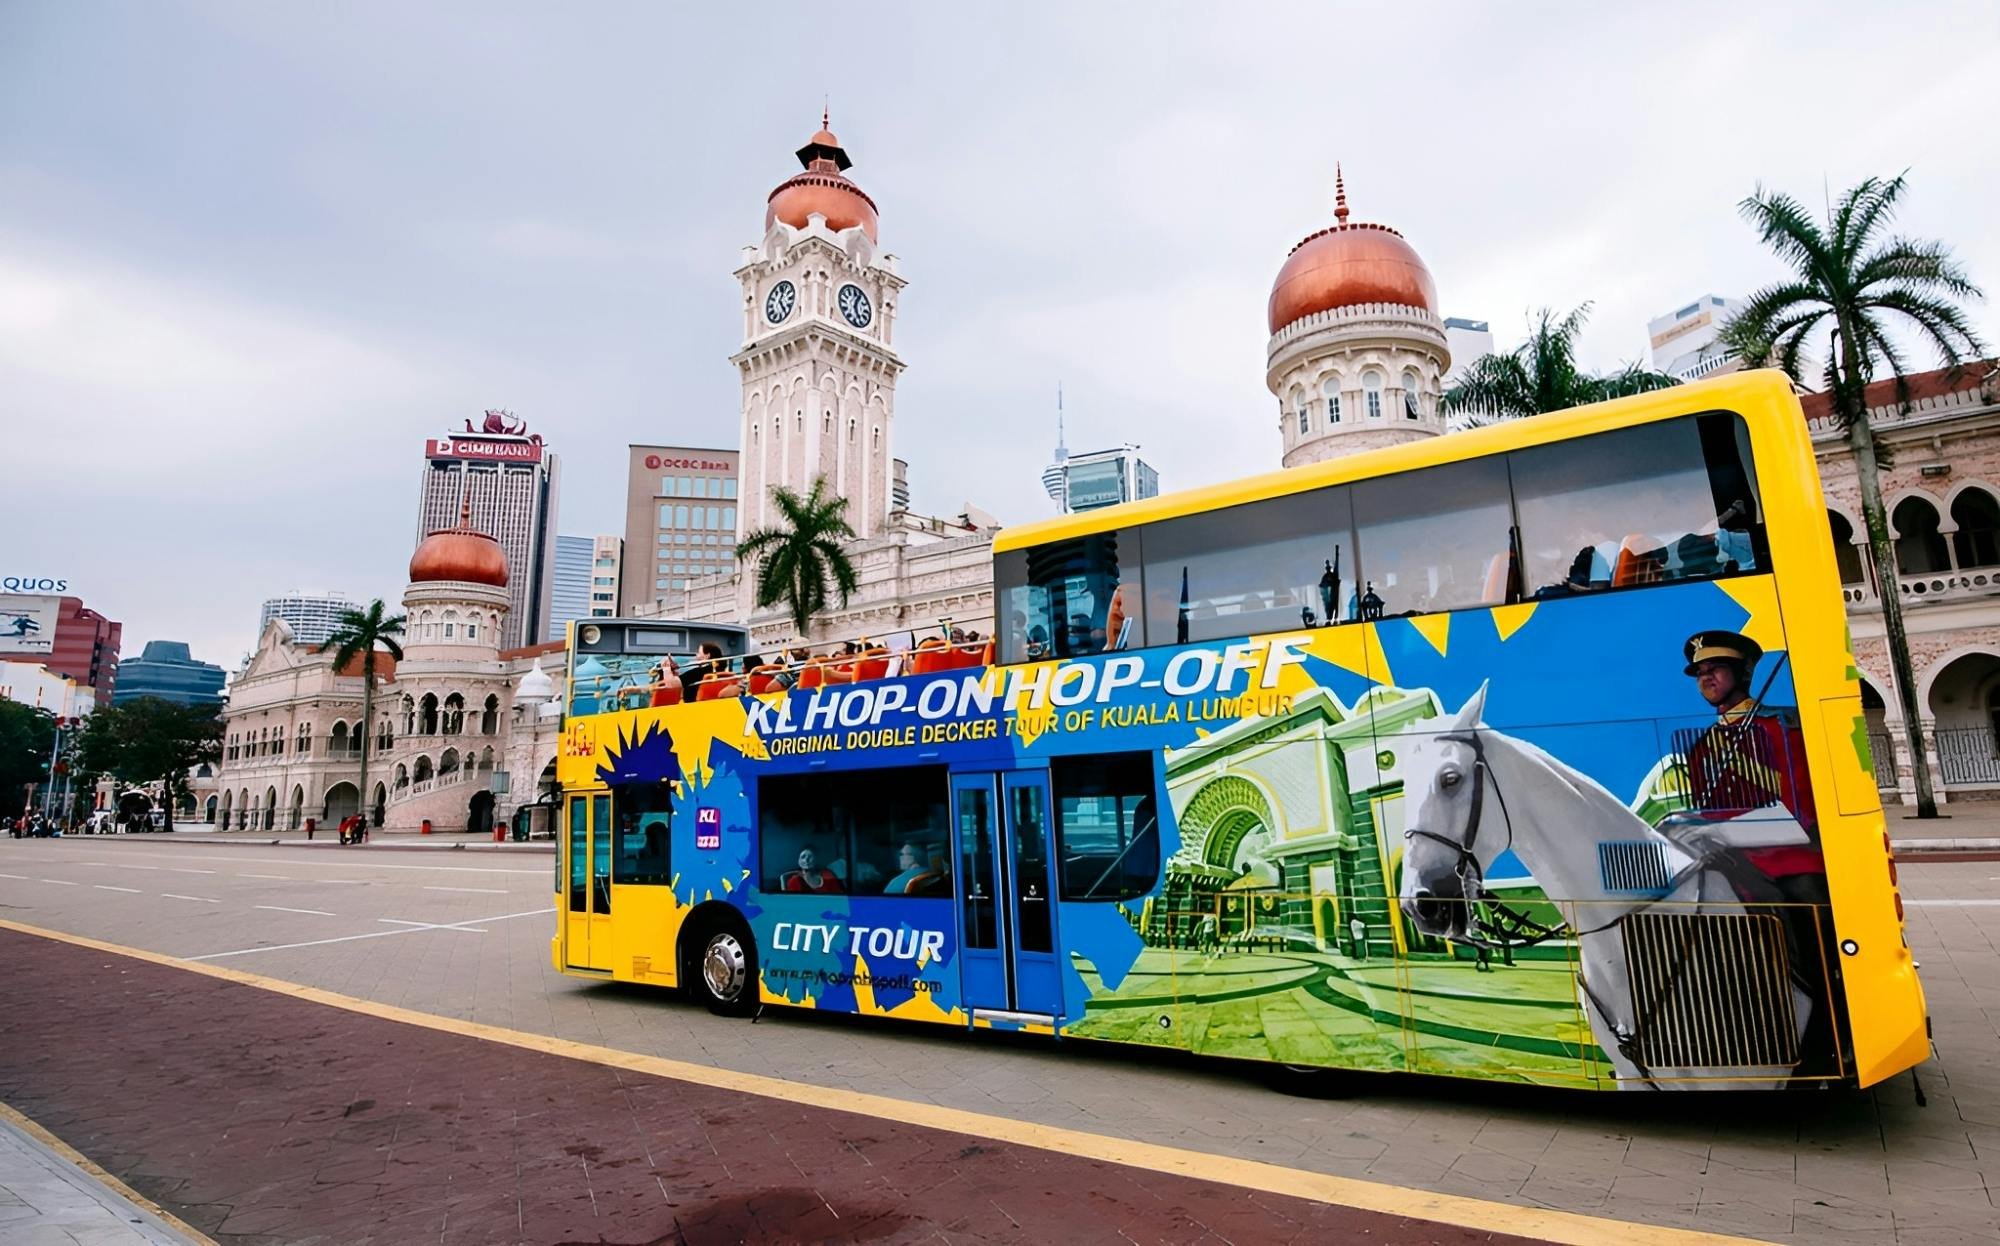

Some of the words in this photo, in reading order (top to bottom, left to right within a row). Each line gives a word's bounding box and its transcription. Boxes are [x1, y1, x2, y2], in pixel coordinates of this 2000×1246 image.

[663, 458, 699, 470] OCBC
[0, 577, 67, 593] QUOS
[743, 698, 797, 736] KL
[802, 675, 995, 731] HOP-ON
[1002, 636, 1314, 712] HOP-OFF
[771, 734, 842, 757] ORIGINAL
[846, 726, 916, 751] DOUBLE
[921, 718, 997, 744] DECKER
[1004, 708, 1060, 736] TOUR
[1064, 708, 1094, 732] OF
[1101, 700, 1180, 728] KUALA
[1188, 694, 1295, 722] LUMPUR
[772, 922, 841, 954] CITY
[848, 926, 945, 963] TOUR
